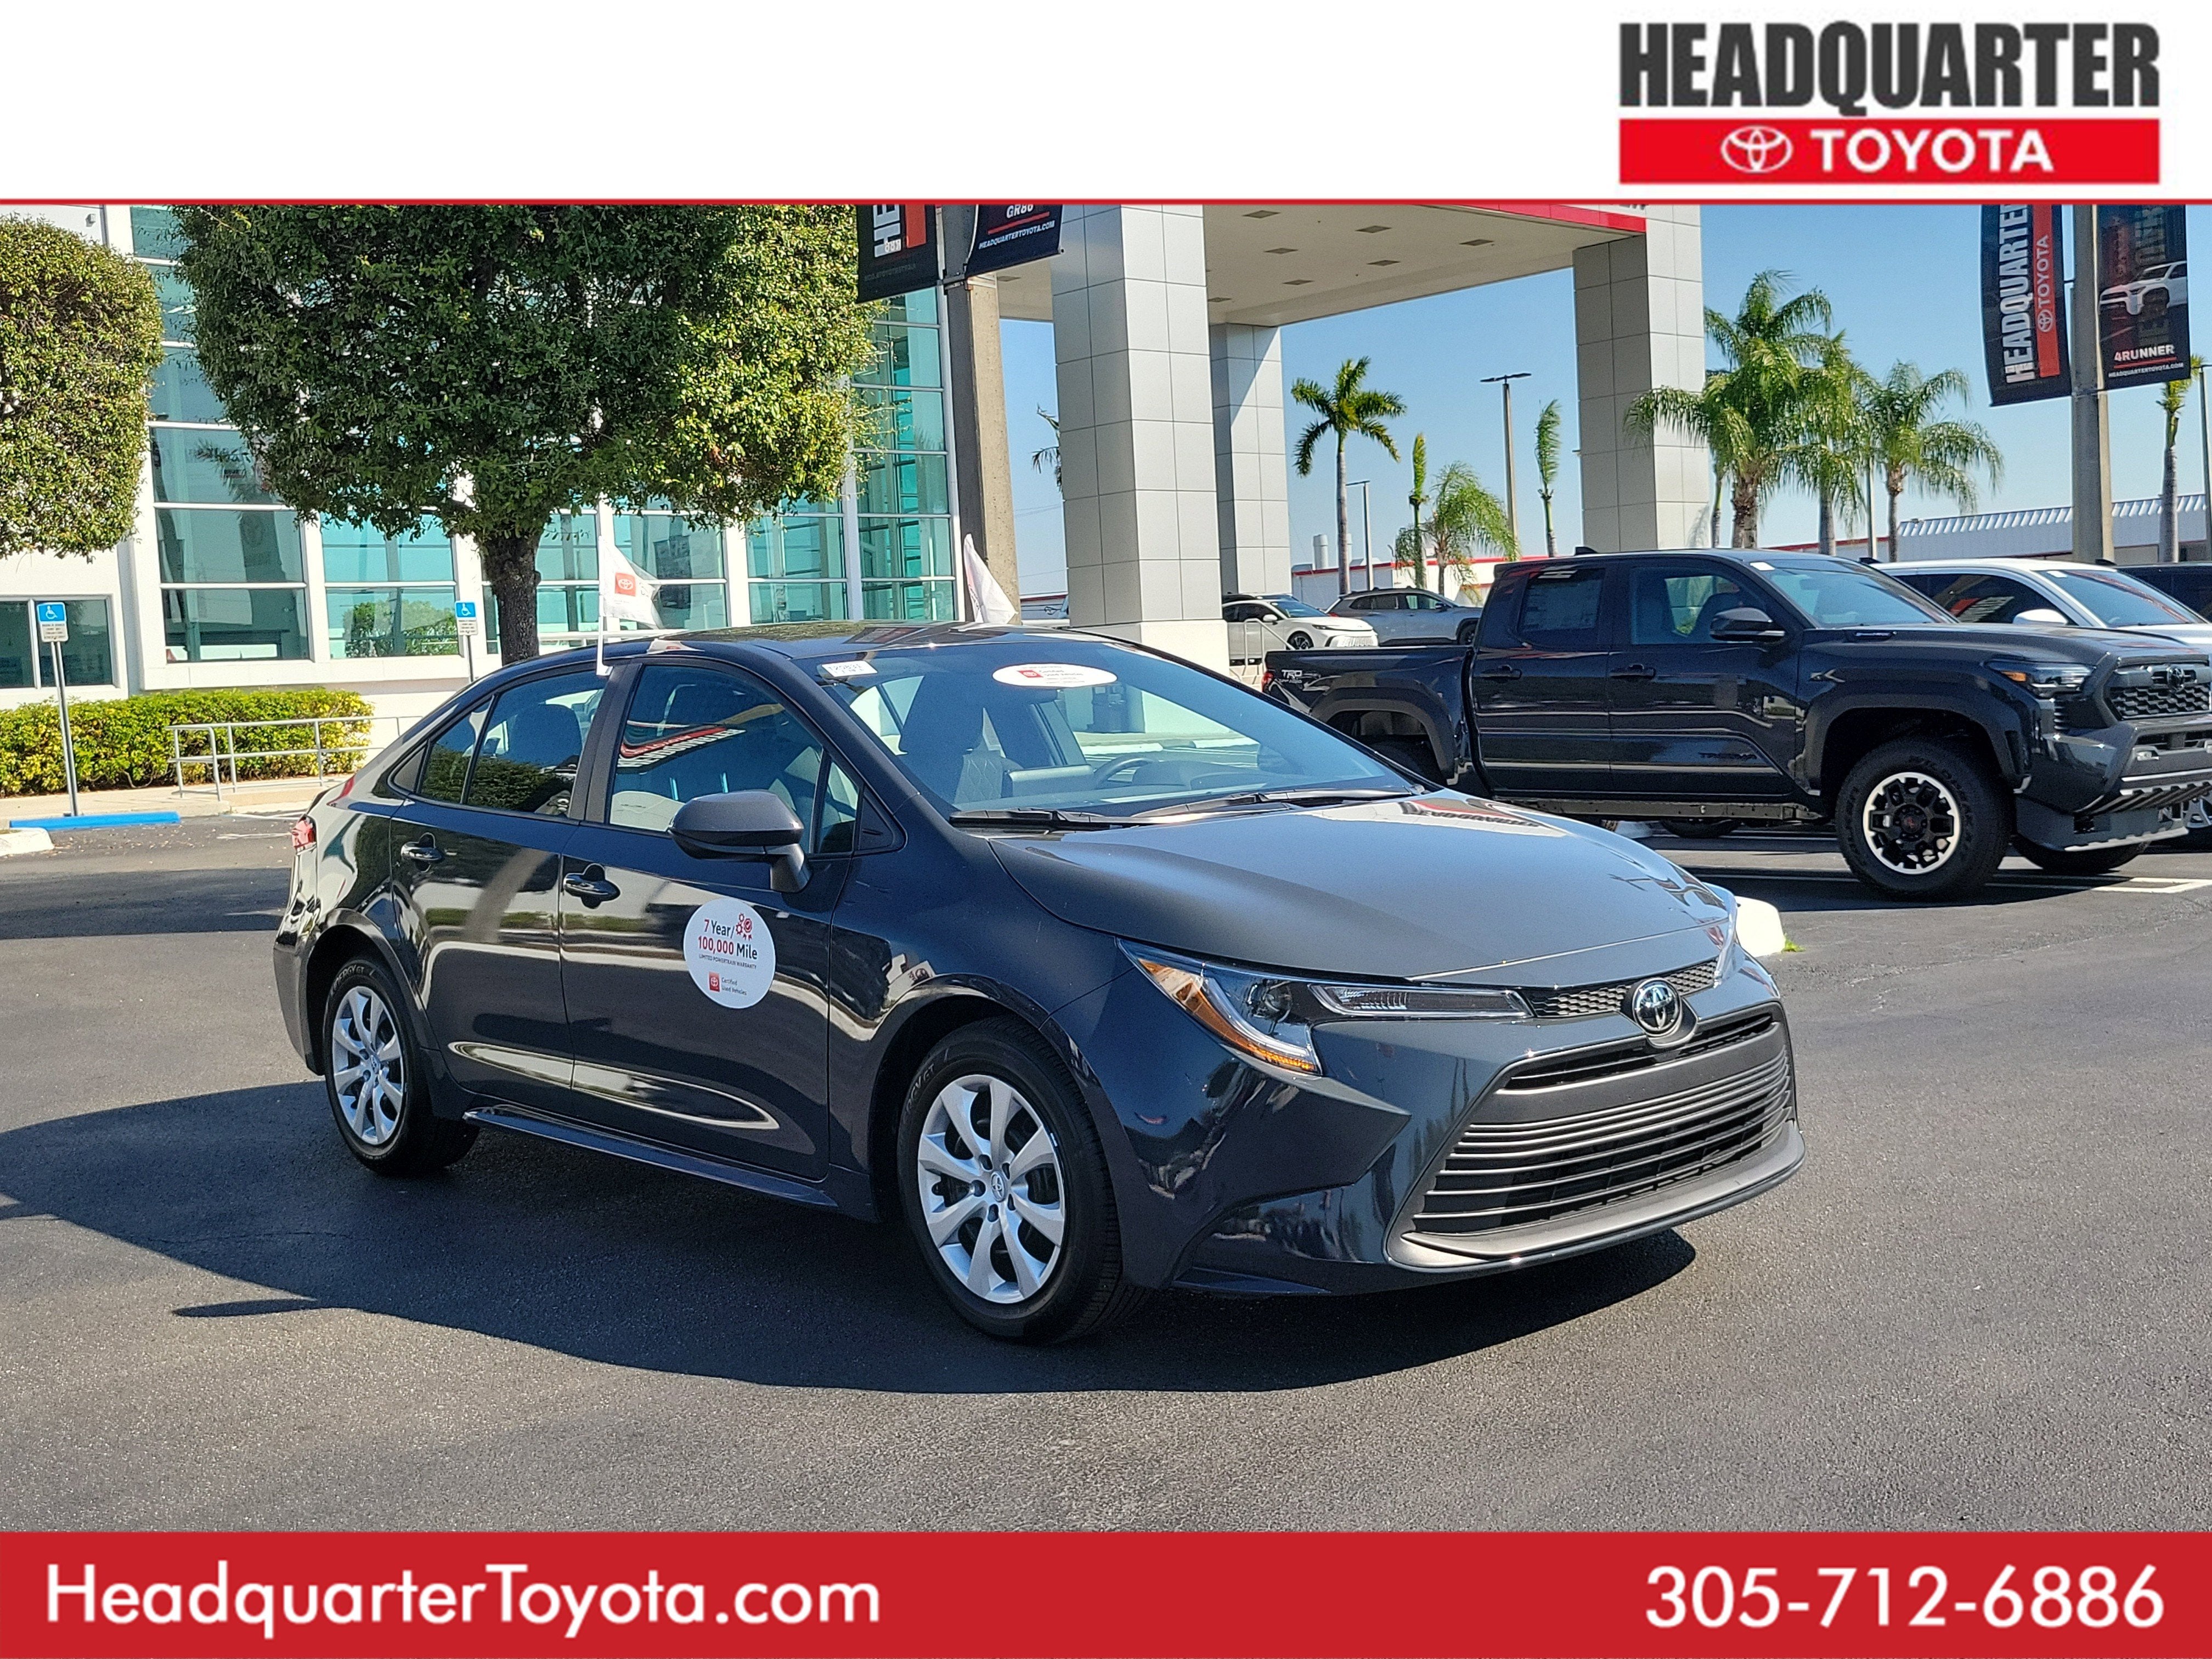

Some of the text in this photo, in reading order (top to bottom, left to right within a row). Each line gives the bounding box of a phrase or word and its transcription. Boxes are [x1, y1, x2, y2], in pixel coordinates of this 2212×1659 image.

[978, 220, 1056, 250] HEADQUARTERTOYOTA.COM
[2036, 235, 2051, 308] TOYOTA
[2114, 345, 2175, 362] 4RUNNER
[2108, 362, 2184, 377] HEADQUARTERTOYOTA.COM
[1282, 669, 1303, 679] TRD
[704, 919, 735, 939] 7 Year/
[698, 935, 758, 960] 100,000 Mile
[713, 956, 736, 965] POWERTRAIN
[736, 961, 757, 969] WARRANTY
